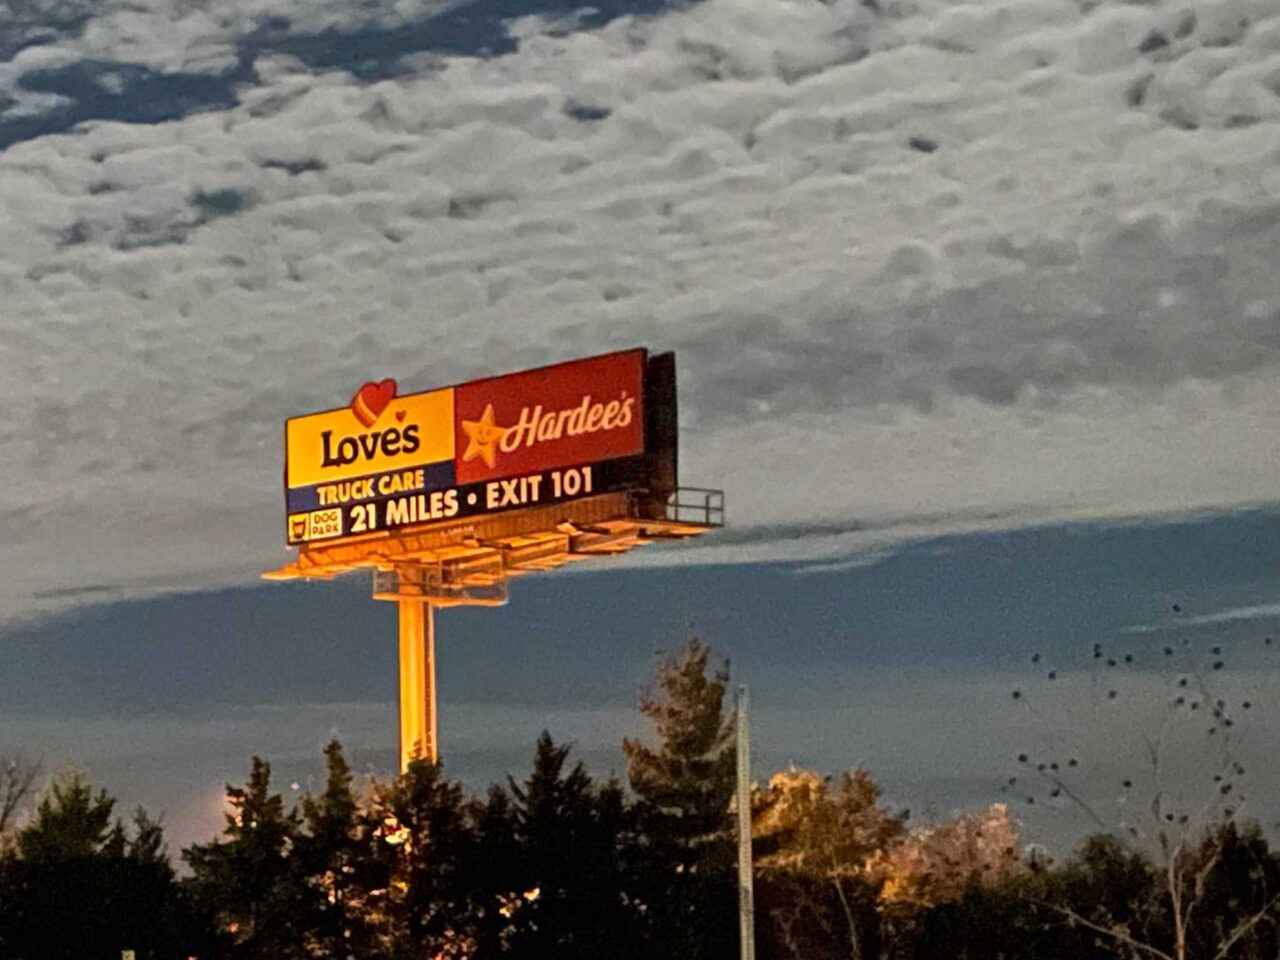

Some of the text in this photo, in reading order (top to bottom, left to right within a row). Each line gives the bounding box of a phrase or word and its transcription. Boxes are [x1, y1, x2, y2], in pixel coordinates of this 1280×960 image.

[499, 390, 635, 453] Hardee's
[317, 469, 425, 506] TRUCK CARE
[349, 465, 592, 533] 21 MILES EXIT 101
[312, 523, 339, 536] PARK
[313, 511, 338, 525] DOG
